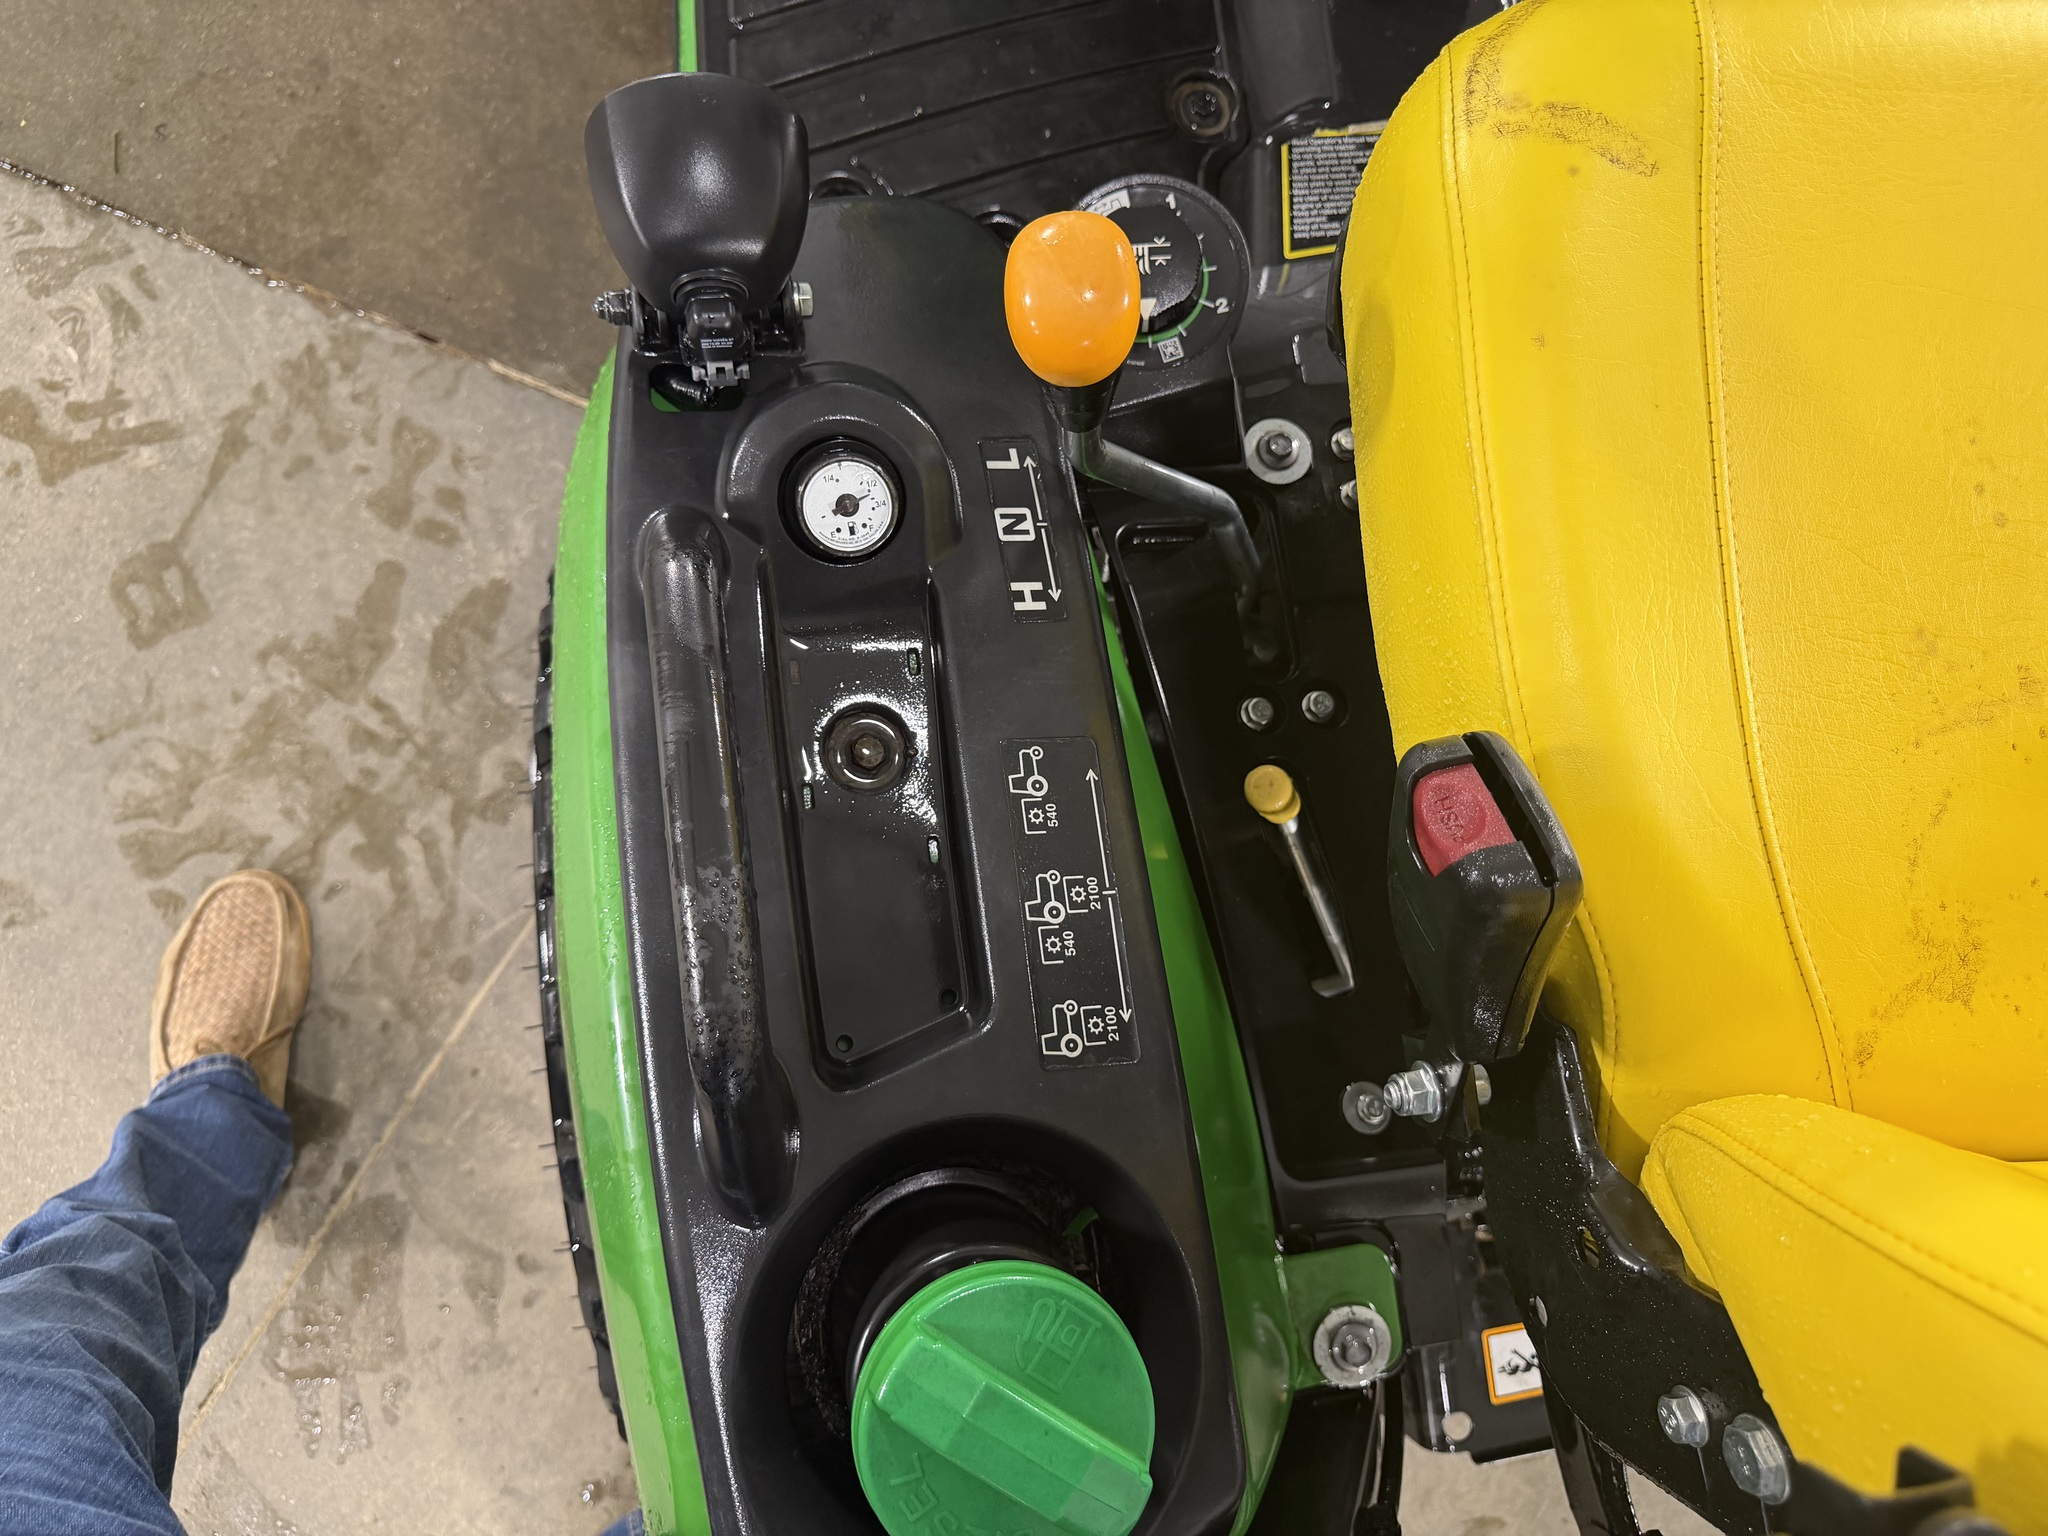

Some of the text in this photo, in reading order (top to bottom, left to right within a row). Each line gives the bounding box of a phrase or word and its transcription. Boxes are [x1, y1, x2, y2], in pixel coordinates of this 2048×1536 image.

[1165, 192, 1176, 210] 1
[1215, 297, 1229, 314] 2
[986, 448, 1020, 470] L
[823, 474, 835, 483] 1/4
[866, 480, 878, 489] 1/2
[875, 500, 887, 508] 3/4
[831, 530, 836, 539] E
[869, 524, 874, 532] F
[998, 511, 1032, 537] N
[1010, 581, 1047, 611] H
[1047, 803, 1058, 827] 540
[1434, 795, 1467, 844] PUSH
[1090, 876, 1102, 910] 2100
[1065, 931, 1076, 956] 540
[1108, 1006, 1120, 1042] 2100
